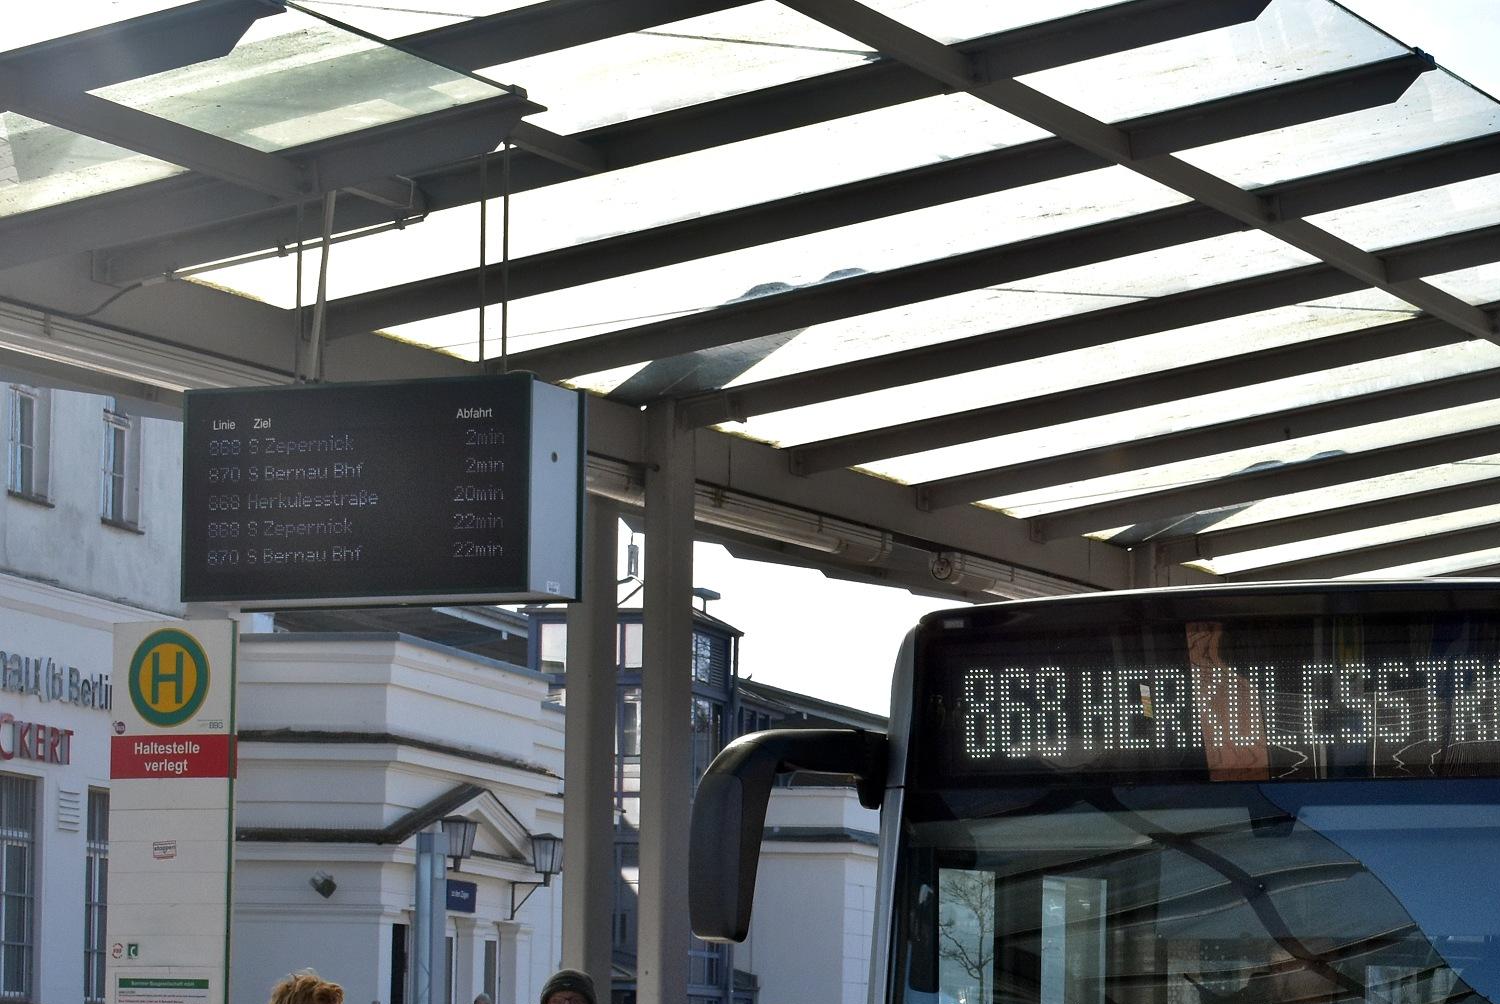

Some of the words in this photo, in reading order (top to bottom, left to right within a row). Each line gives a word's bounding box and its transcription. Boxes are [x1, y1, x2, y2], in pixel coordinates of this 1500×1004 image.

[212, 419, 236, 431] Linie
[253, 418, 271, 429] Ziel
[456, 407, 493, 419] Abfahrt
[248, 438, 259, 455] S
[264, 434, 355, 456] Zepernick
[466, 428, 505, 446] 2min
[208, 466, 241, 482] 870
[248, 465, 259, 481] S
[264, 463, 328, 481] Bernau
[333, 461, 365, 479] Bhf
[465, 456, 505, 474] 2min
[248, 489, 379, 511] Herkulesstraße
[453, 485, 505, 502] 20min
[247, 521, 258, 537] S
[263, 517, 354, 539] Zepernick
[453, 513, 504, 530] 22min
[207, 549, 240, 566] 870
[247, 548, 258, 564] S
[263, 546, 327, 564] Bernau
[332, 544, 363, 562] Bhf
[452, 541, 503, 558] 22min
[151, 652, 184, 704] H
[965, 667, 1067, 758] 868
[134, 741, 200, 755] Haltestelle
[144, 759, 188, 774] verlegt
